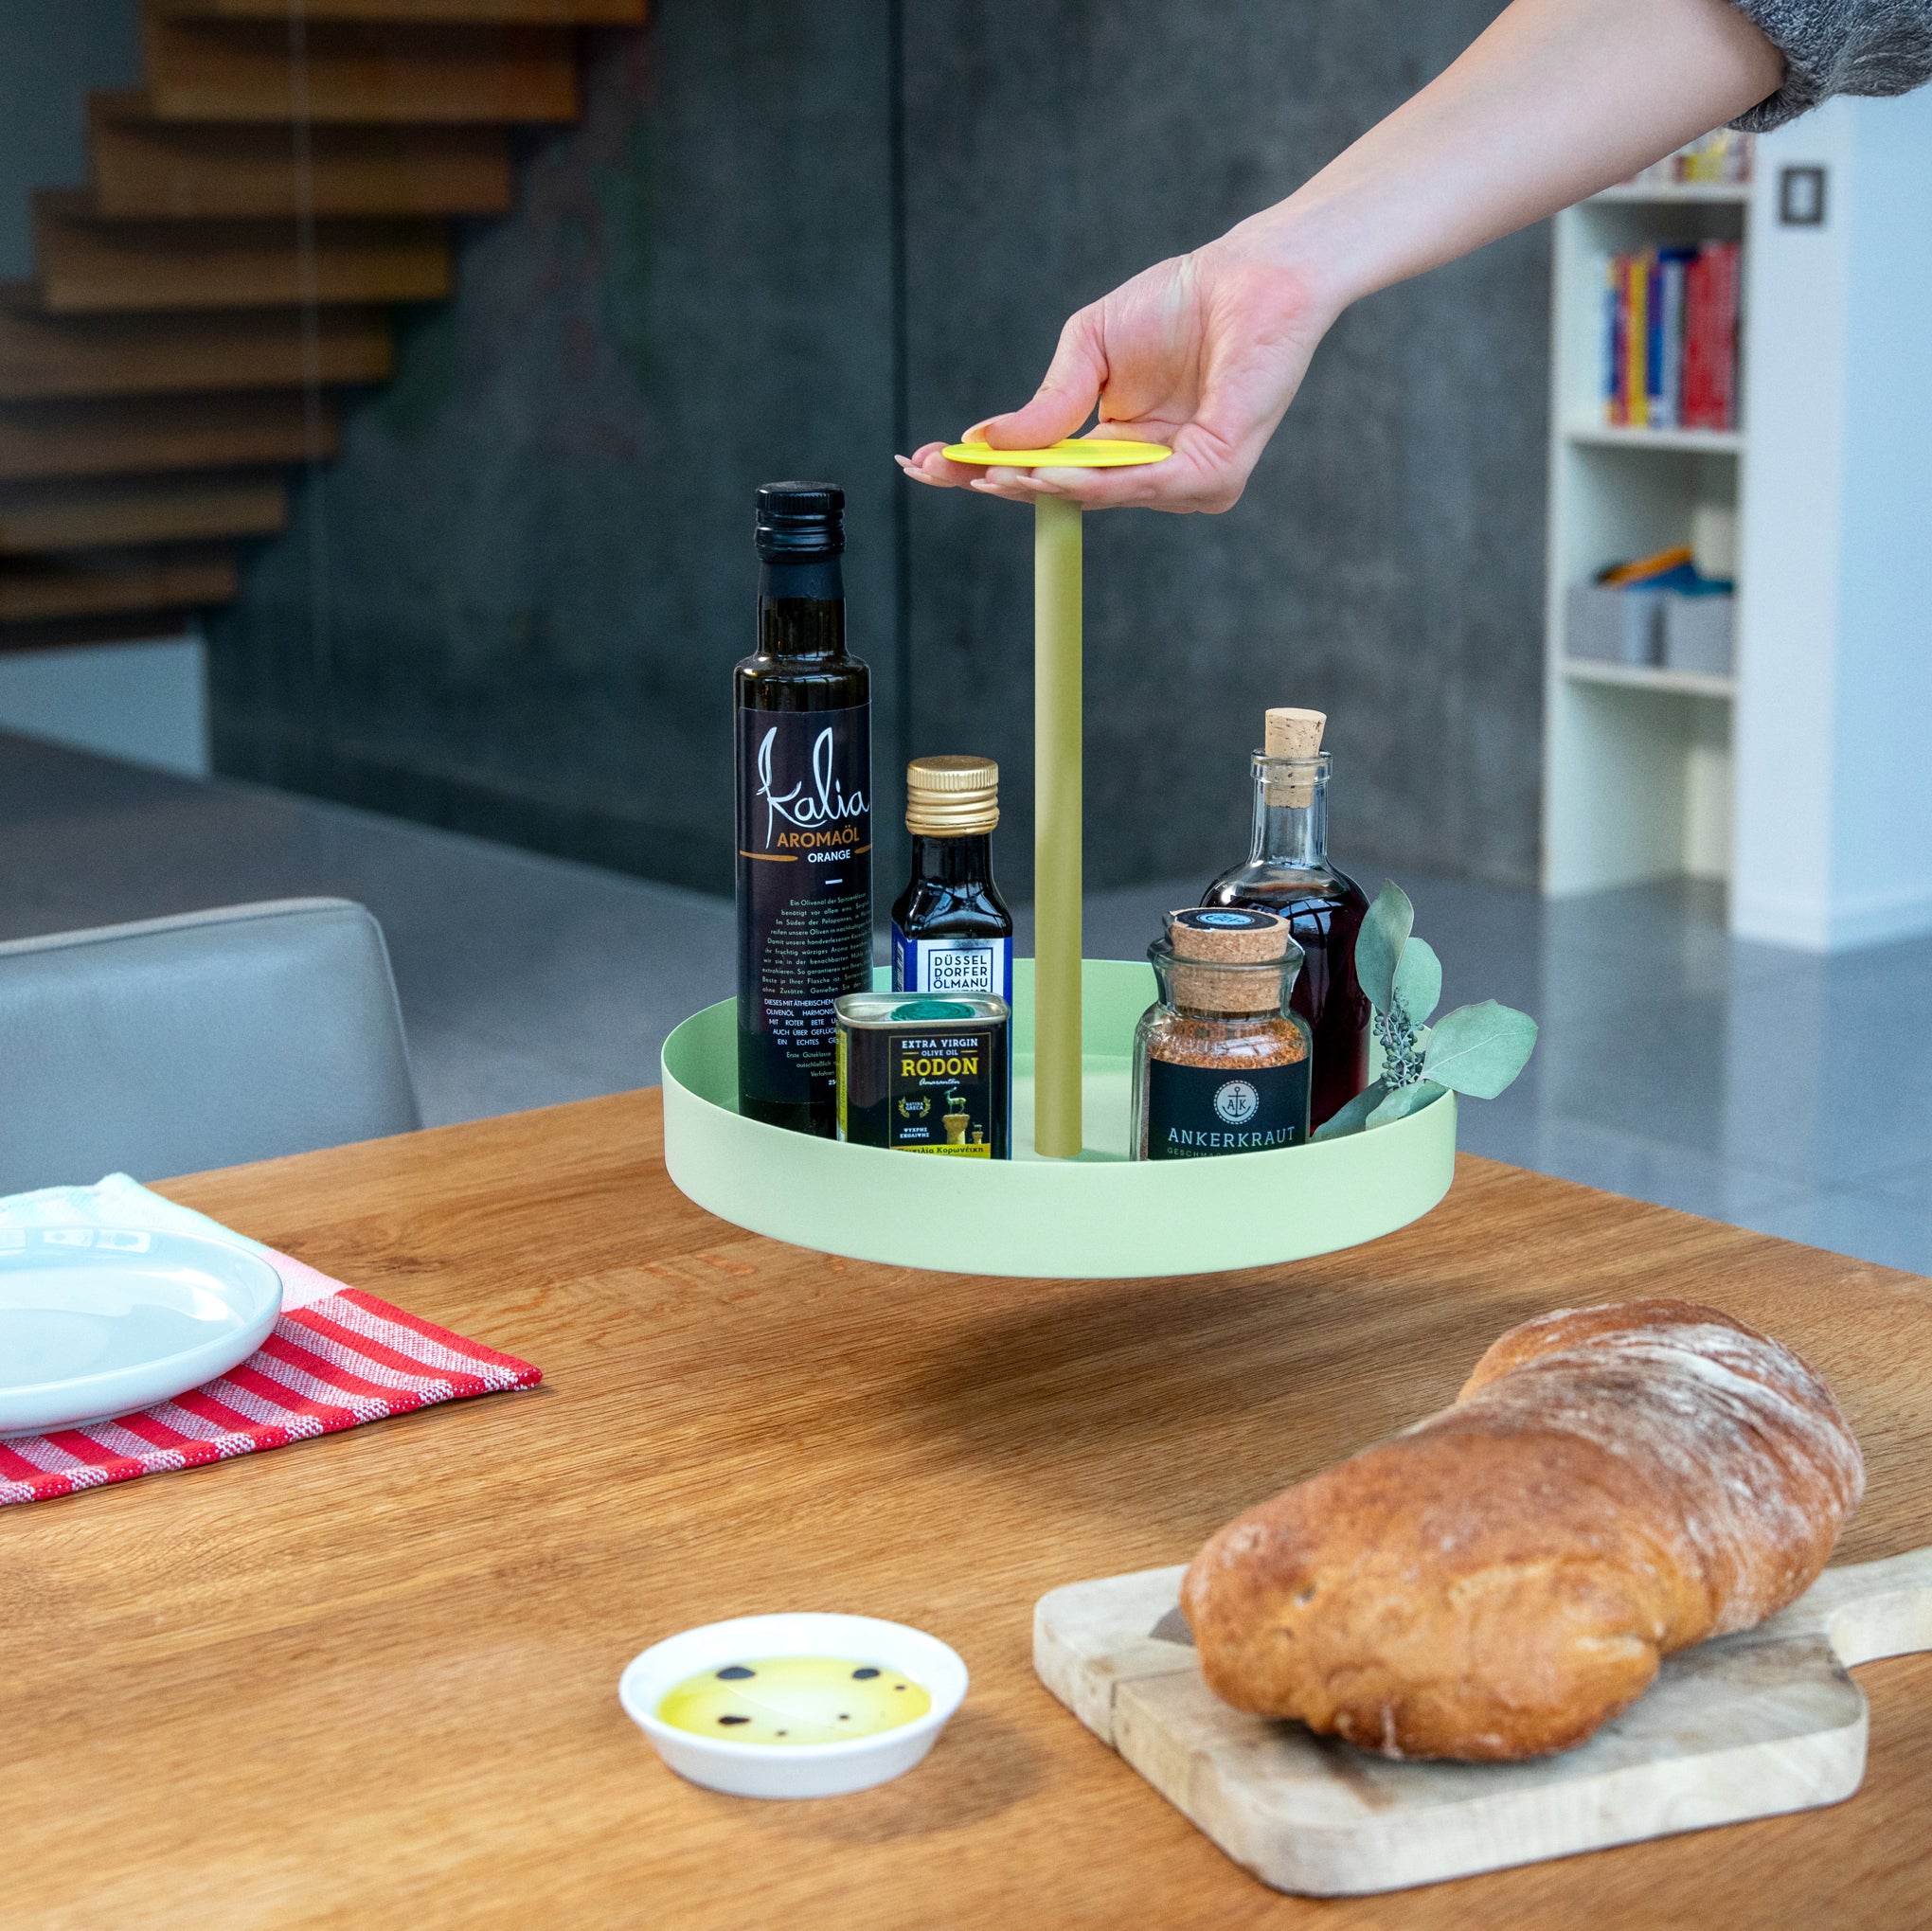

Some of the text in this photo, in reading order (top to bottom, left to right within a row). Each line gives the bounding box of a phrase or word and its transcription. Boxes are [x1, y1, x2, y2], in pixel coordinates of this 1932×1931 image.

[777, 824, 859, 848] AROMAÖL
[808, 849, 851, 863] ORANGE
[810, 956, 849, 965] benachbarten
[935, 955, 987, 966] DÜSSEL
[806, 966, 841, 975] garantieren
[934, 966, 988, 977] DORFER
[933, 977, 988, 989] ÖLMANU
[810, 986, 839, 994] Genießen
[766, 1008, 835, 1016] OLIVENÖL HARMONIS
[902, 1038, 978, 1049] EXTRA VIRGIN
[901, 1057, 979, 1076] RODON
[1168, 1126, 1295, 1147] ANKERKRAUT
